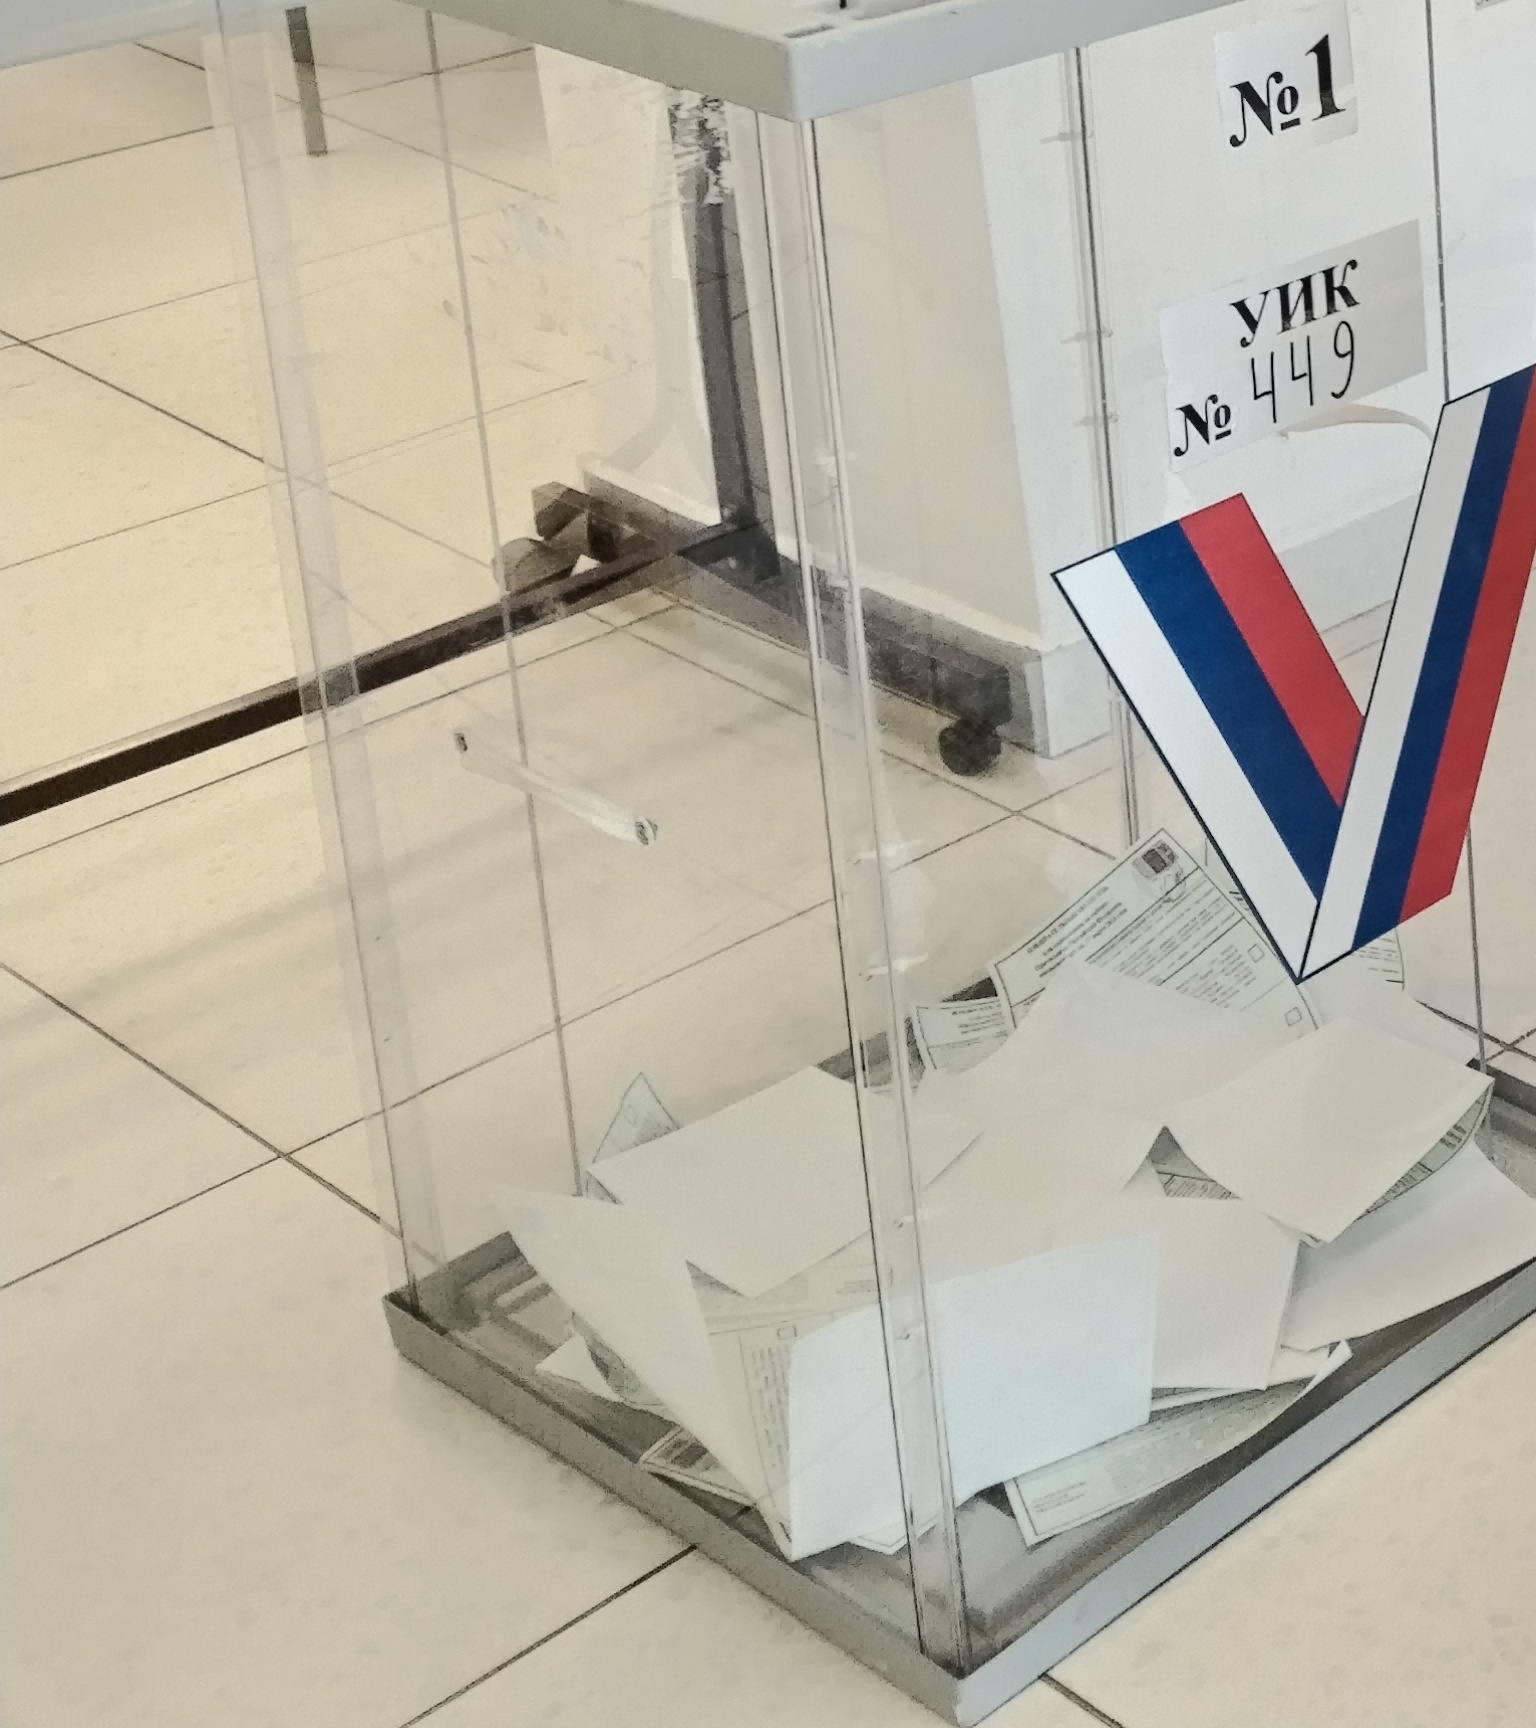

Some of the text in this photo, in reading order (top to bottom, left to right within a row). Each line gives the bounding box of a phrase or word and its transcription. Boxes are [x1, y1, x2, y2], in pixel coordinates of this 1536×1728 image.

[1230, 259, 1361, 348] УИК
[1173, 320, 1356, 458] № 449
